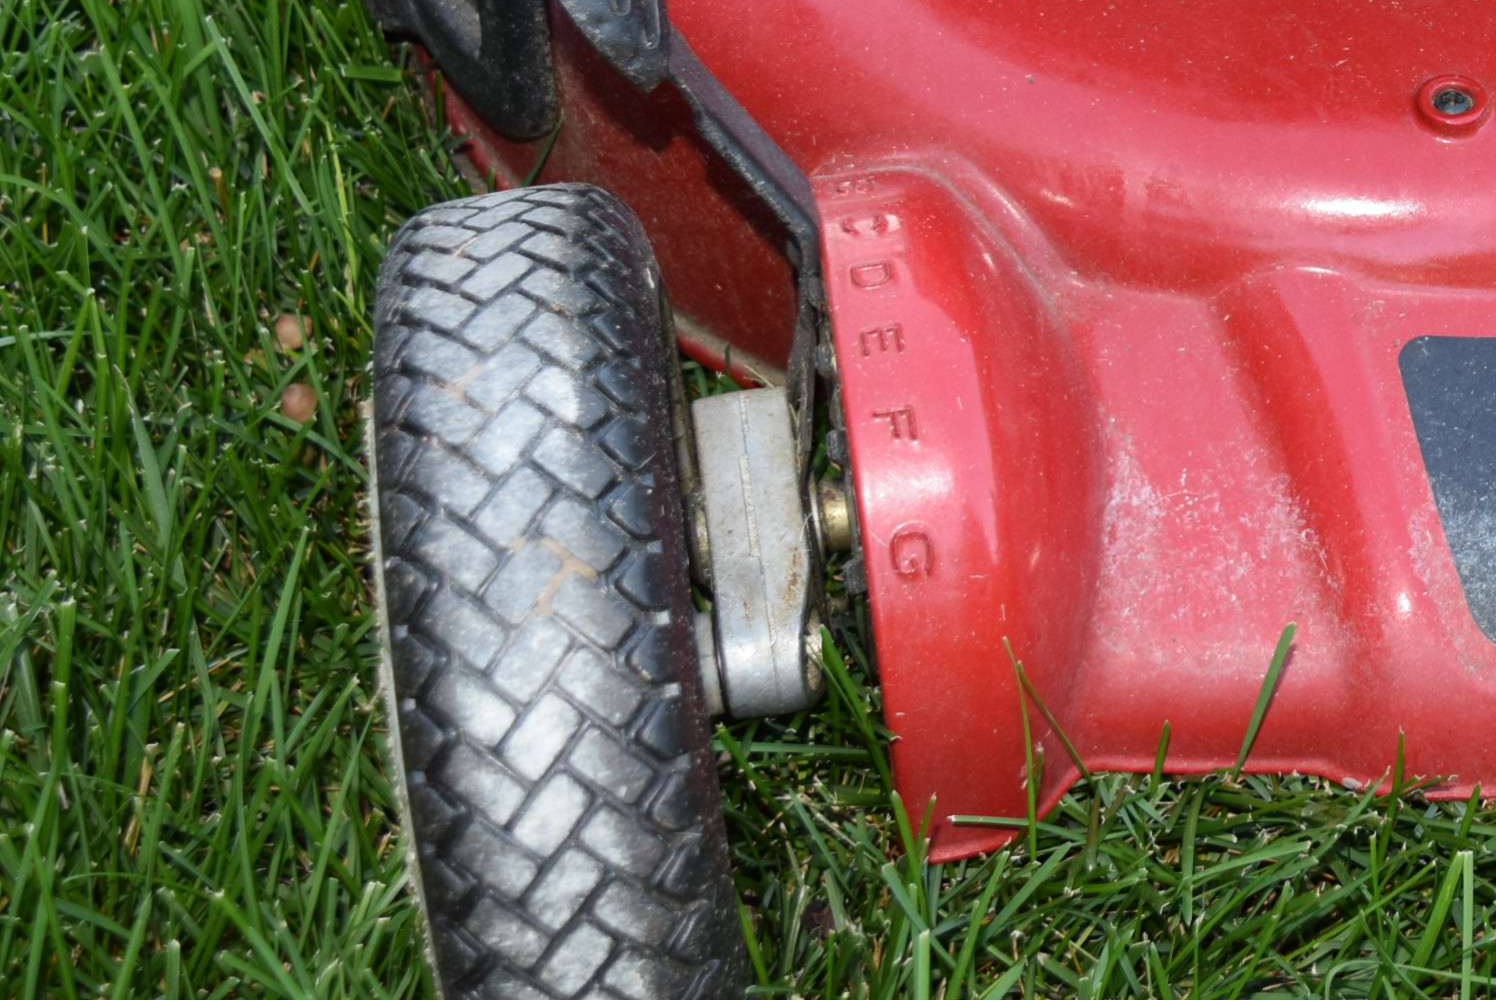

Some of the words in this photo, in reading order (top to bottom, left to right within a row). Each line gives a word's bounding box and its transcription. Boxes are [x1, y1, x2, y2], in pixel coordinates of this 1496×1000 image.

[849, 261, 892, 289] D
[859, 323, 906, 357] E
[872, 405, 918, 442] F
[889, 529, 935, 578] G
